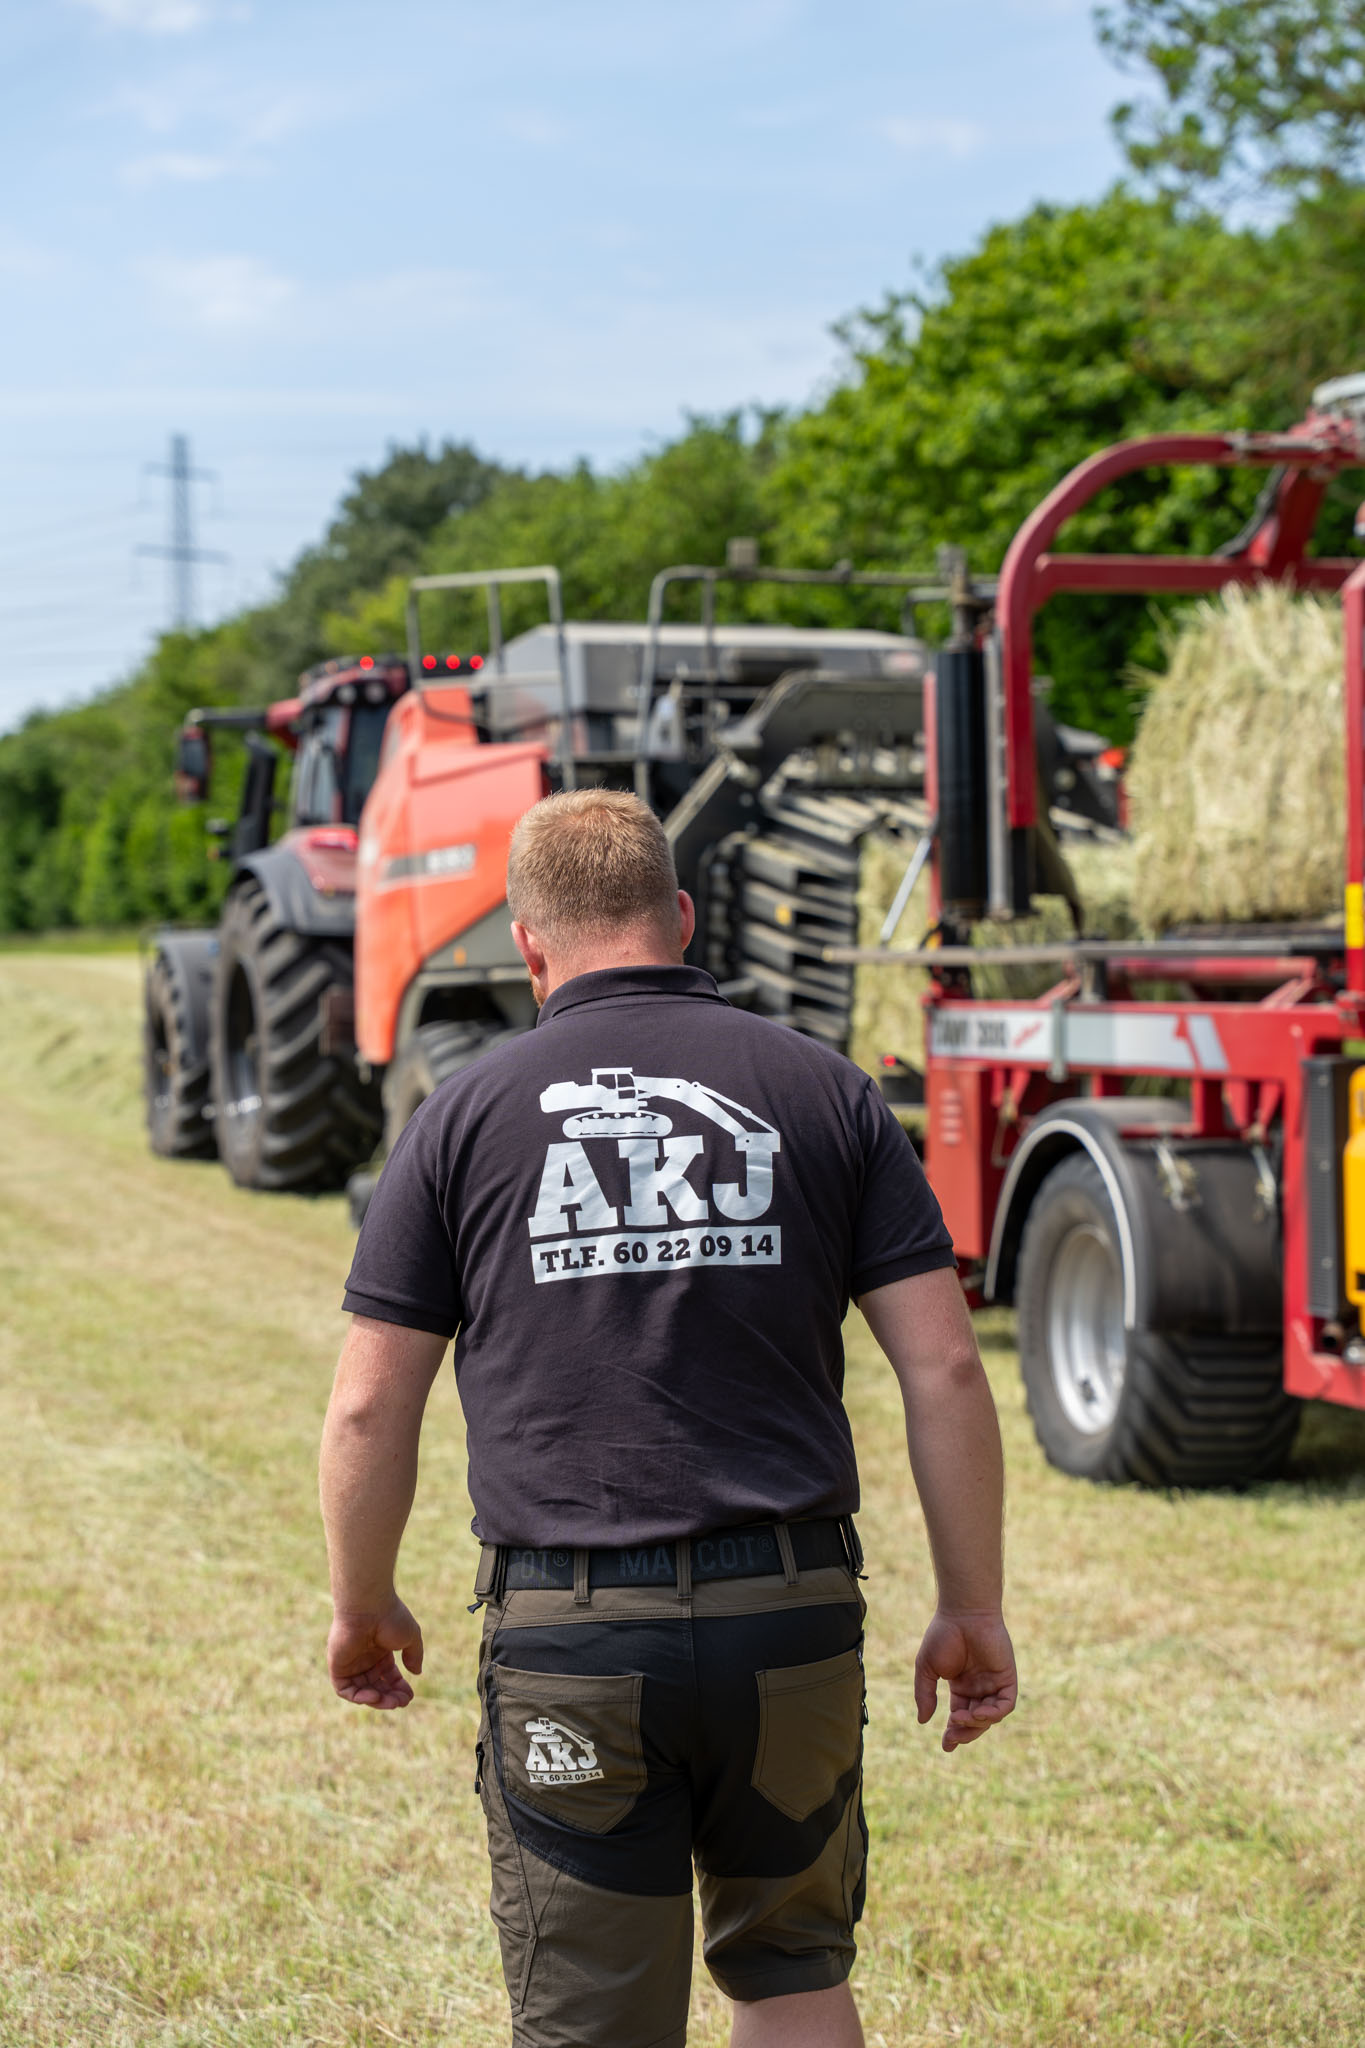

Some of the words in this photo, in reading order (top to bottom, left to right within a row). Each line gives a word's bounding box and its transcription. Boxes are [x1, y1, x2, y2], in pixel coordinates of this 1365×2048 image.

[528, 1132, 781, 1238] AKJ
[540, 1246, 605, 1274] TLF.
[613, 1241, 649, 1264] 60
[657, 1237, 691, 1262] 22
[700, 1234, 733, 1257] 09
[740, 1233, 774, 1257] 14
[525, 1742, 598, 1772] AKJ
[549, 1774, 561, 1782] 60
[575, 1773, 587, 1781] 09
